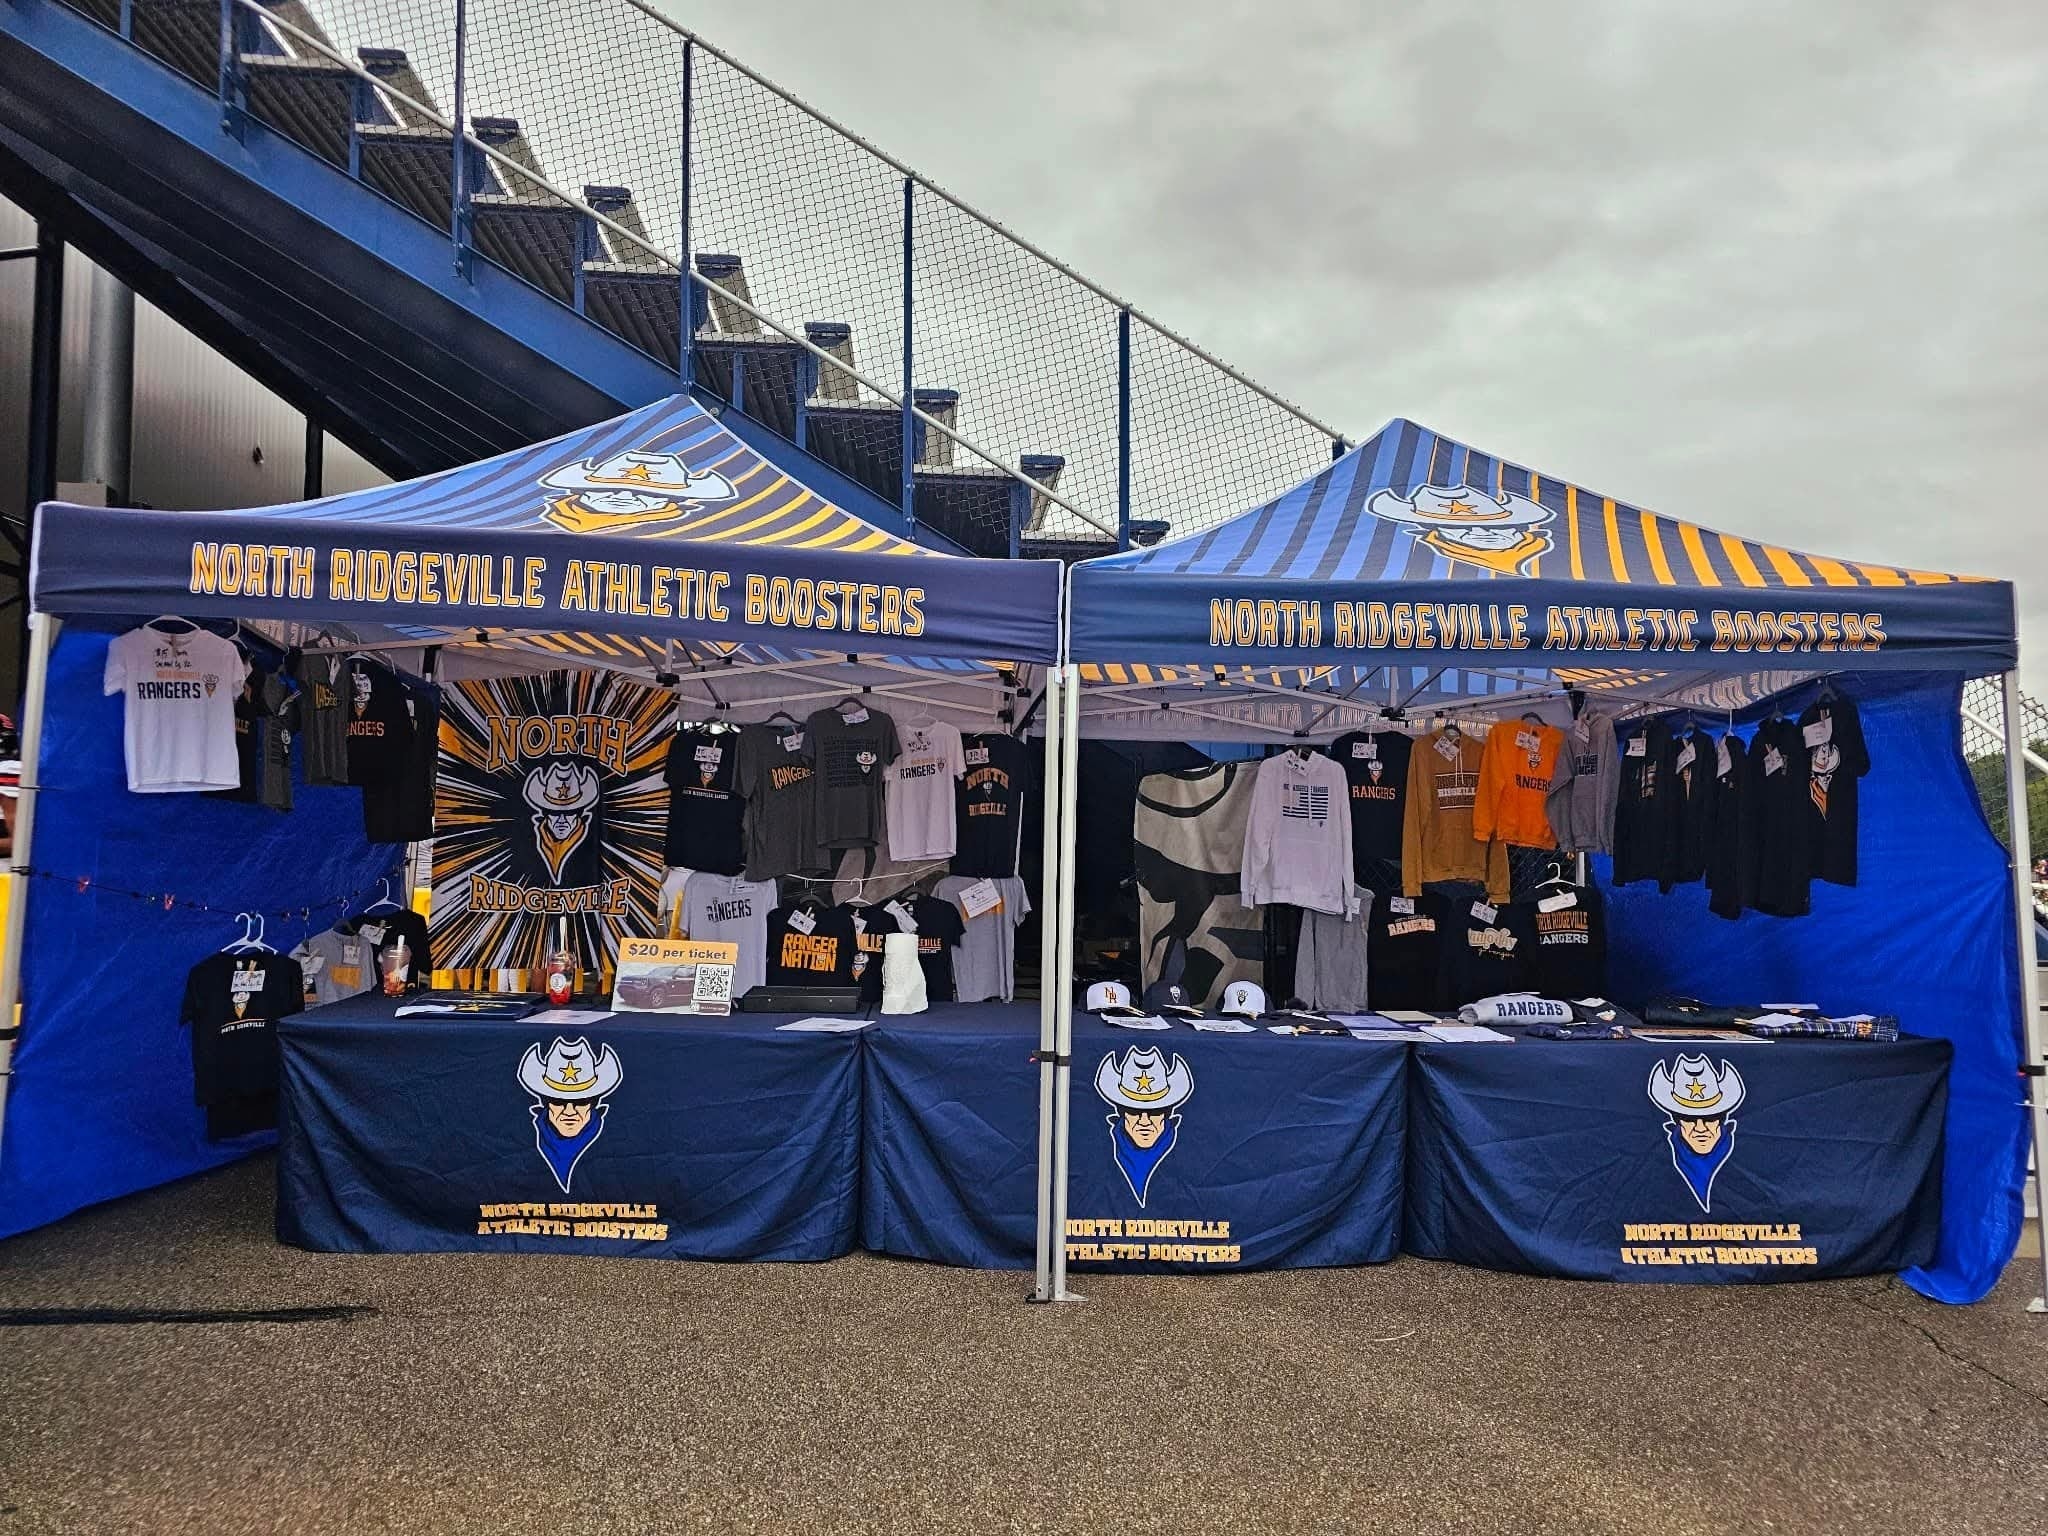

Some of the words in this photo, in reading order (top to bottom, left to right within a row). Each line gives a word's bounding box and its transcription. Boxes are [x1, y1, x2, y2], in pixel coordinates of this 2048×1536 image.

[191, 542, 315, 599] NORTH
[329, 548, 546, 608] RIDGEVILLE
[560, 559, 731, 621] ATHLETIC
[745, 574, 925, 637] BOOSTERS
[1209, 598, 1322, 648] NORTH
[1333, 601, 1530, 650] RIDGEVILLE
[1543, 605, 1701, 651] ATHLETIC
[1710, 610, 1887, 652] BOOSTERS
[137, 682, 201, 699] RANGERS
[487, 714, 632, 777] NORTH
[771, 766, 812, 790] RANGERS
[900, 763, 936, 780] RANGERS
[1352, 785, 1396, 800] RANGERS
[628, 943, 659, 957] $20
[662, 949, 686, 959] per
[689, 948, 728, 960] ticket
[783, 933, 838, 953] RANGER
[780, 949, 837, 972] NATION
[1496, 1001, 1564, 1017] RANGERS
[479, 1203, 546, 1218] NORTH
[549, 1203, 658, 1218] RIDGEVILLE
[477, 1218, 571, 1236] ATHLETIC
[573, 1221, 669, 1241] BOOSTERS
[1125, 1219, 1230, 1238] RIDGEVILLE
[1623, 1223, 1688, 1241] NORTH
[1690, 1223, 1802, 1241] RIDGEVILLE
[1065, 1243, 1146, 1261] THLETIC
[1148, 1244, 1241, 1263] BOOSTERS
[1620, 1247, 1715, 1265] ATHLETIC
[1714, 1247, 1819, 1265] BOOSTERS
